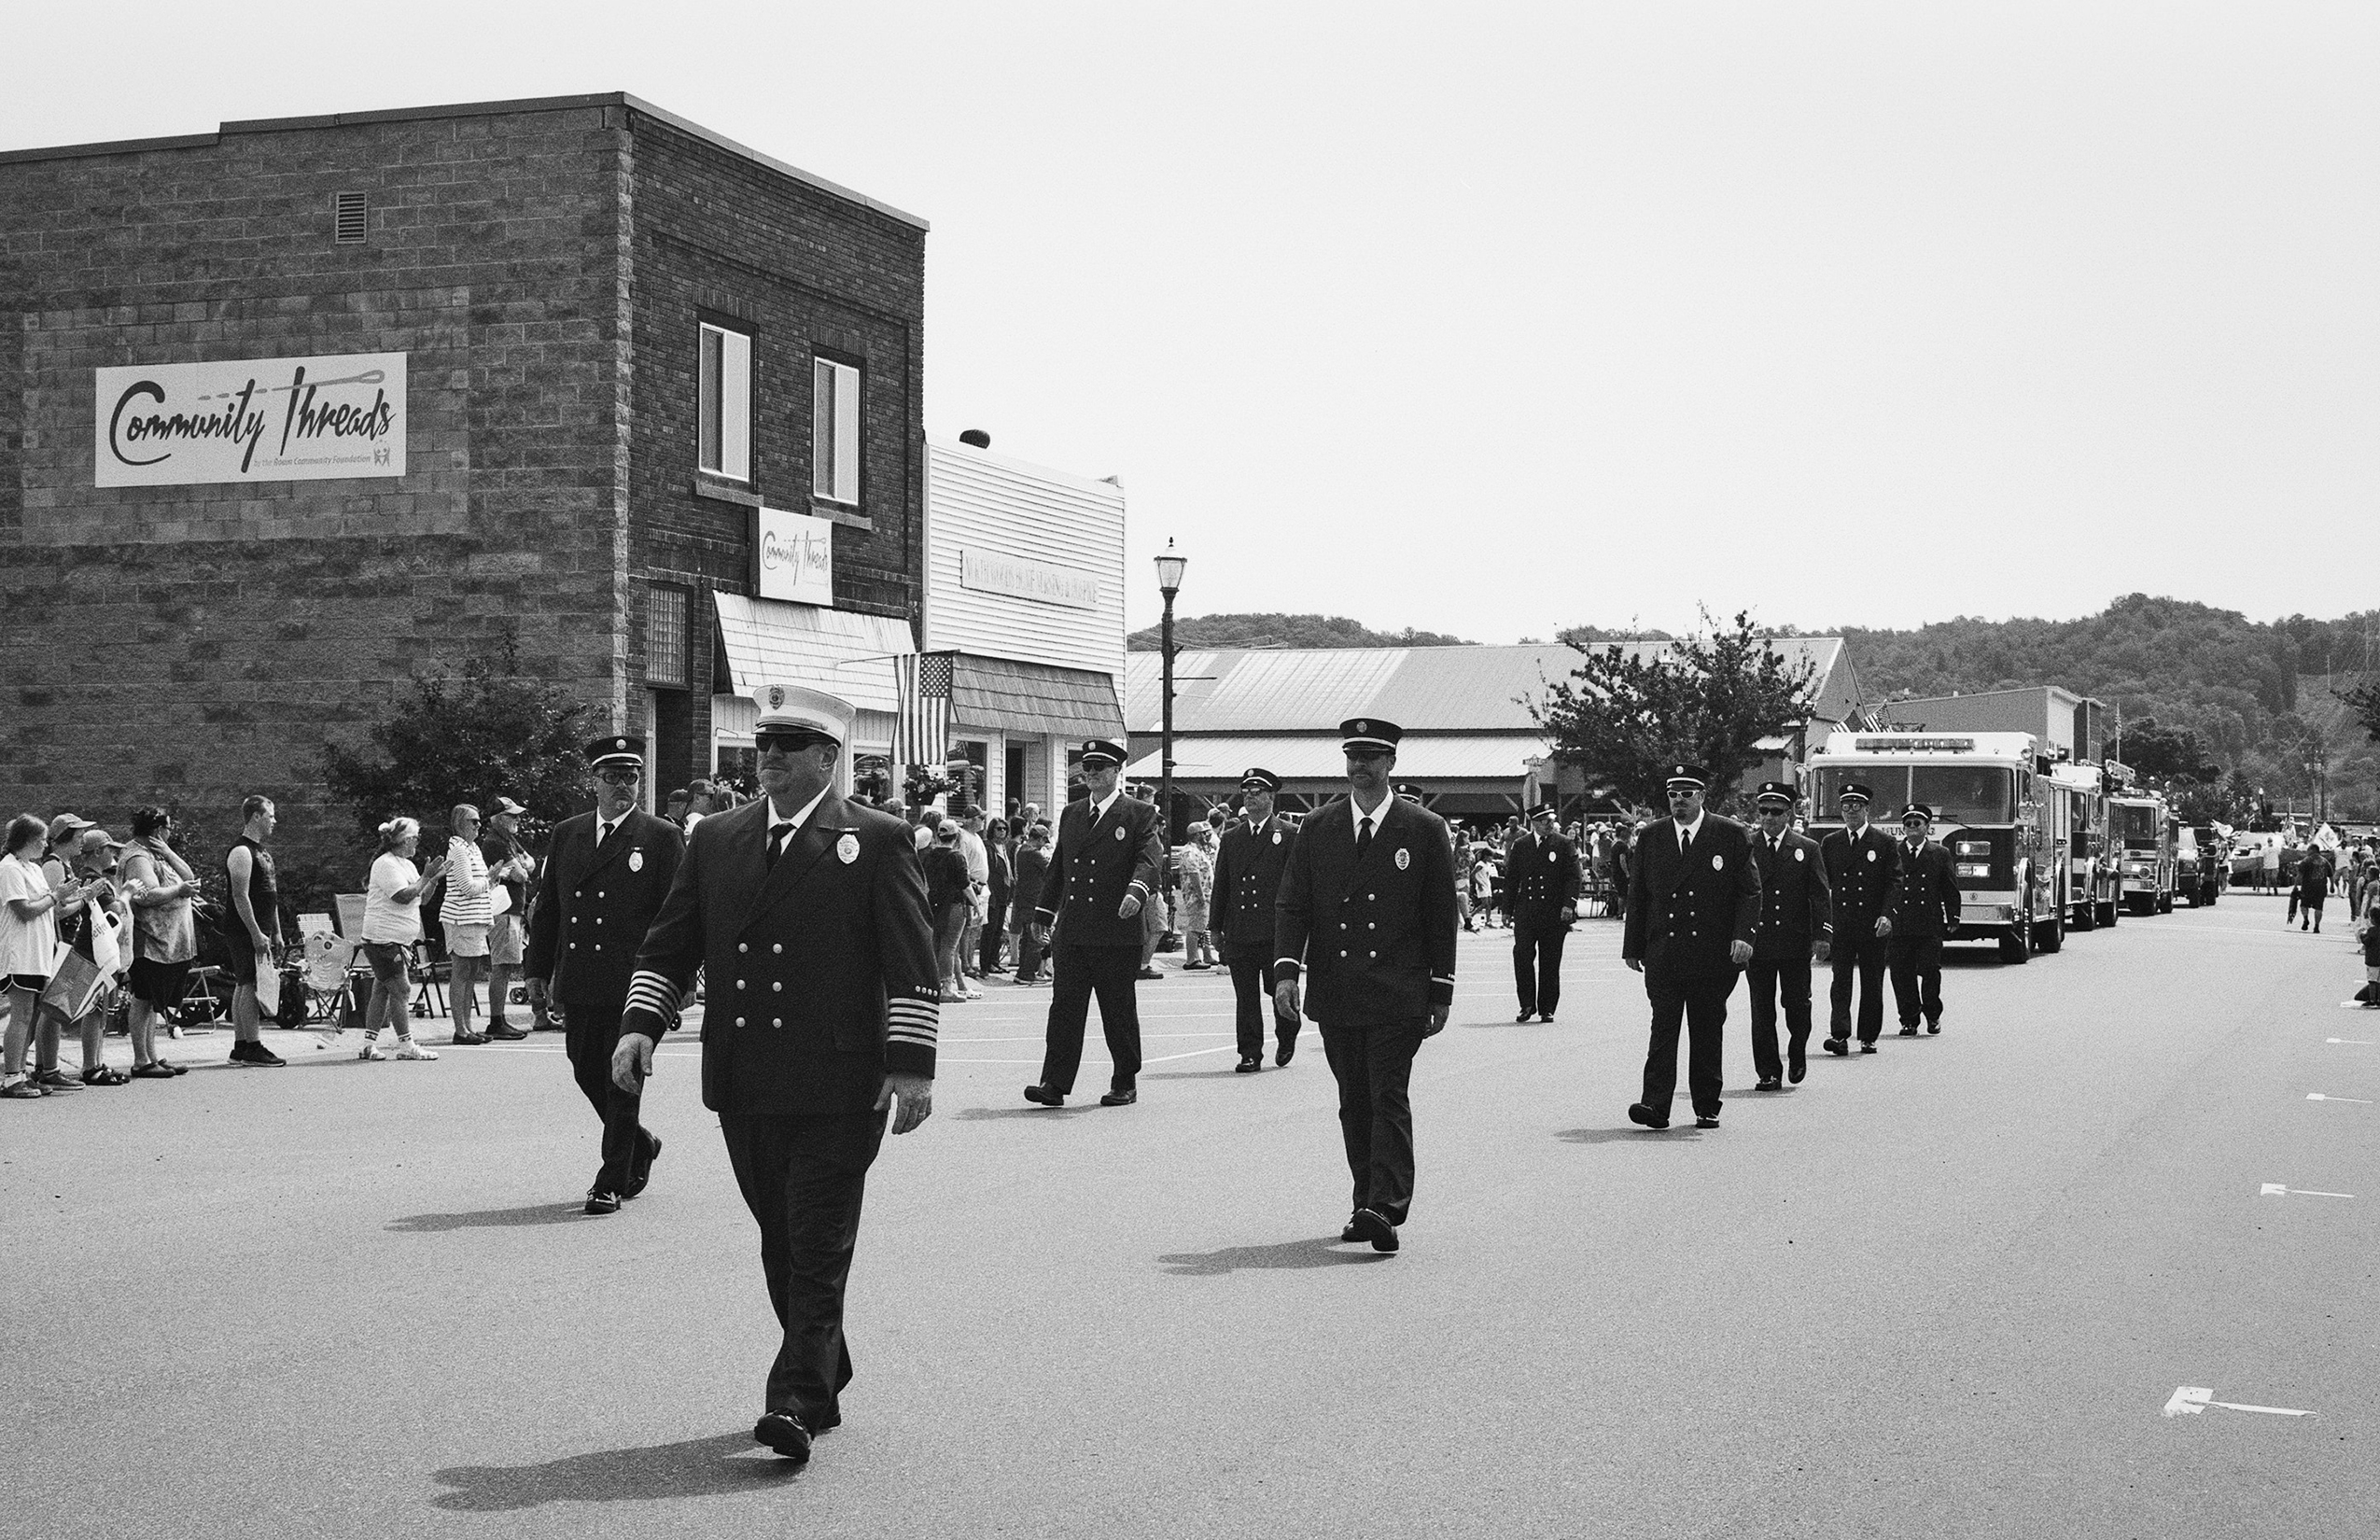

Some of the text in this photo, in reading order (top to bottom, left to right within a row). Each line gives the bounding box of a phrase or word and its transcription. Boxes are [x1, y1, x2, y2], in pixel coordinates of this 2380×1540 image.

[109, 366, 397, 473] Community Threads
[332, 454, 371, 465] Foundation
[762, 530, 828, 586] Community Threads
